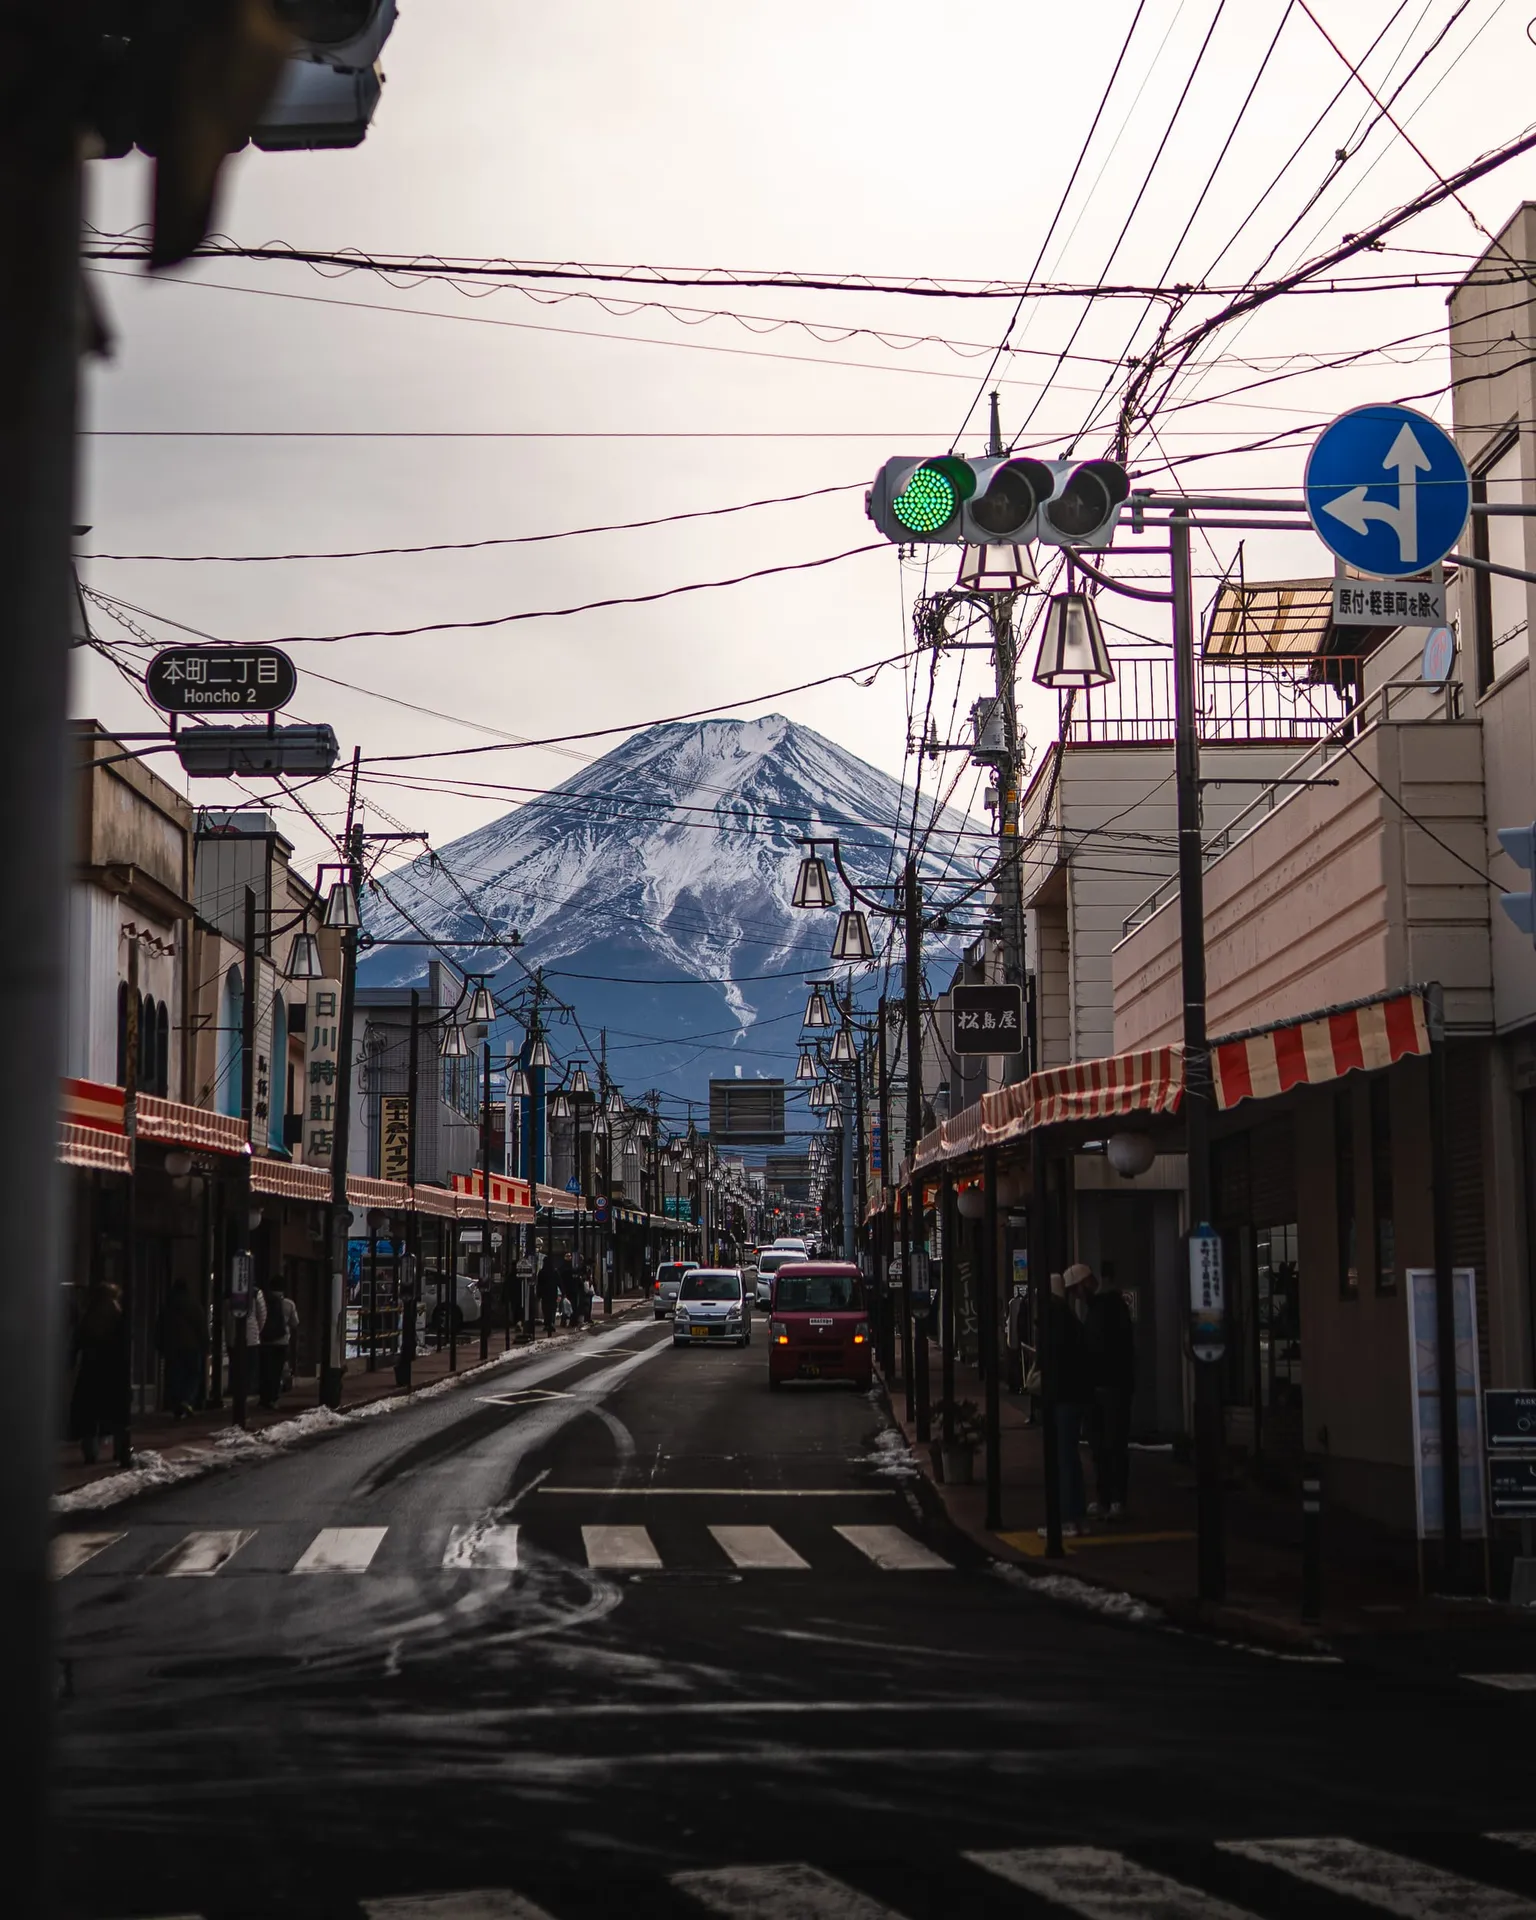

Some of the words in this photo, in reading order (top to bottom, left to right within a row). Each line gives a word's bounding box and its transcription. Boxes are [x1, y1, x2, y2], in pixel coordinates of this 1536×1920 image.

[1339, 588, 1440, 618] 原付・軽車両を除く
[162, 657, 278, 685] 本町二丁目
[184, 688, 240, 703] Honcho
[246, 688, 257, 703] 2
[957, 1010, 1017, 1030] 松島屋
[308, 992, 337, 1155] 日川時計店
[385, 1098, 409, 1180] 富士急ハイラン
